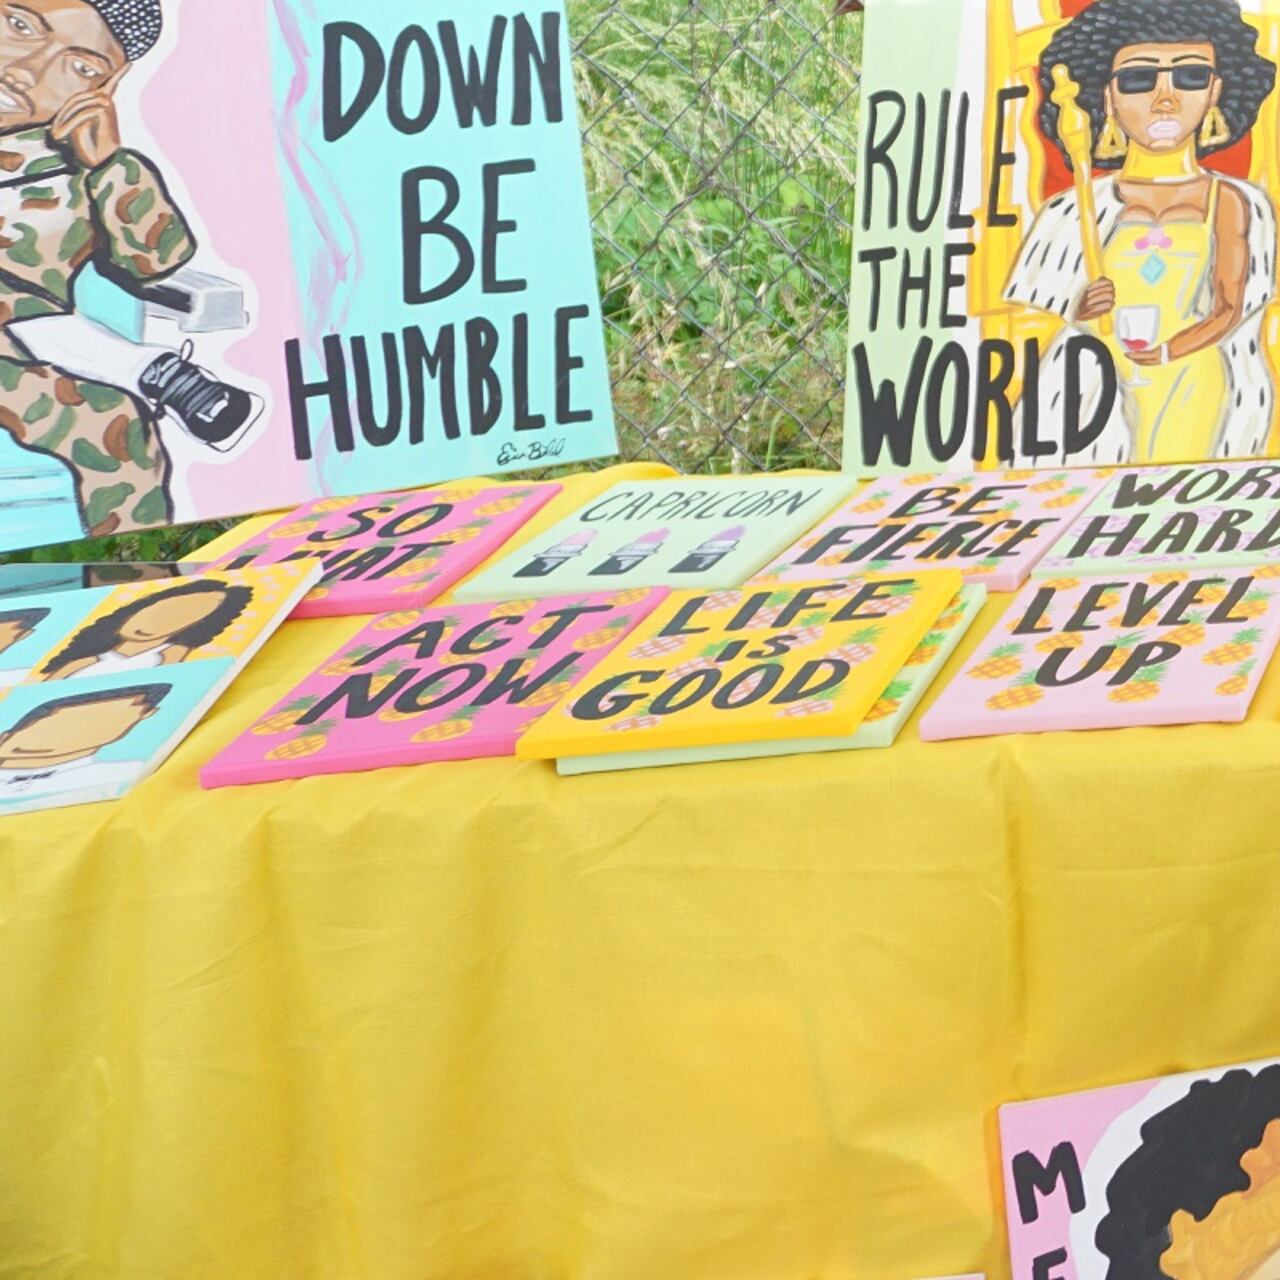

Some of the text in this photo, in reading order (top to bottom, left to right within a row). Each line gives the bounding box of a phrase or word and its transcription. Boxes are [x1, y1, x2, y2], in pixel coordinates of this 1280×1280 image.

[322, 12, 563, 142] DOWN
[861, 85, 1030, 233] RULE
[401, 158, 536, 305] BE
[859, 242, 975, 334] THE
[284, 305, 593, 461] HUMBLE
[852, 336, 1117, 469] WORLD
[306, 503, 455, 542] SO
[580, 487, 823, 523] CAPRICORN
[889, 484, 1028, 519] BE
[793, 516, 1062, 565] FIERCE
[351, 604, 617, 668] ACT
[658, 579, 917, 637] LIFE
[1011, 575, 1257, 636] LEVEL
[716, 634, 797, 663] IS
[1034, 642, 1182, 687] UP
[295, 651, 580, 726] NOW
[571, 658, 851, 721] GOOD
